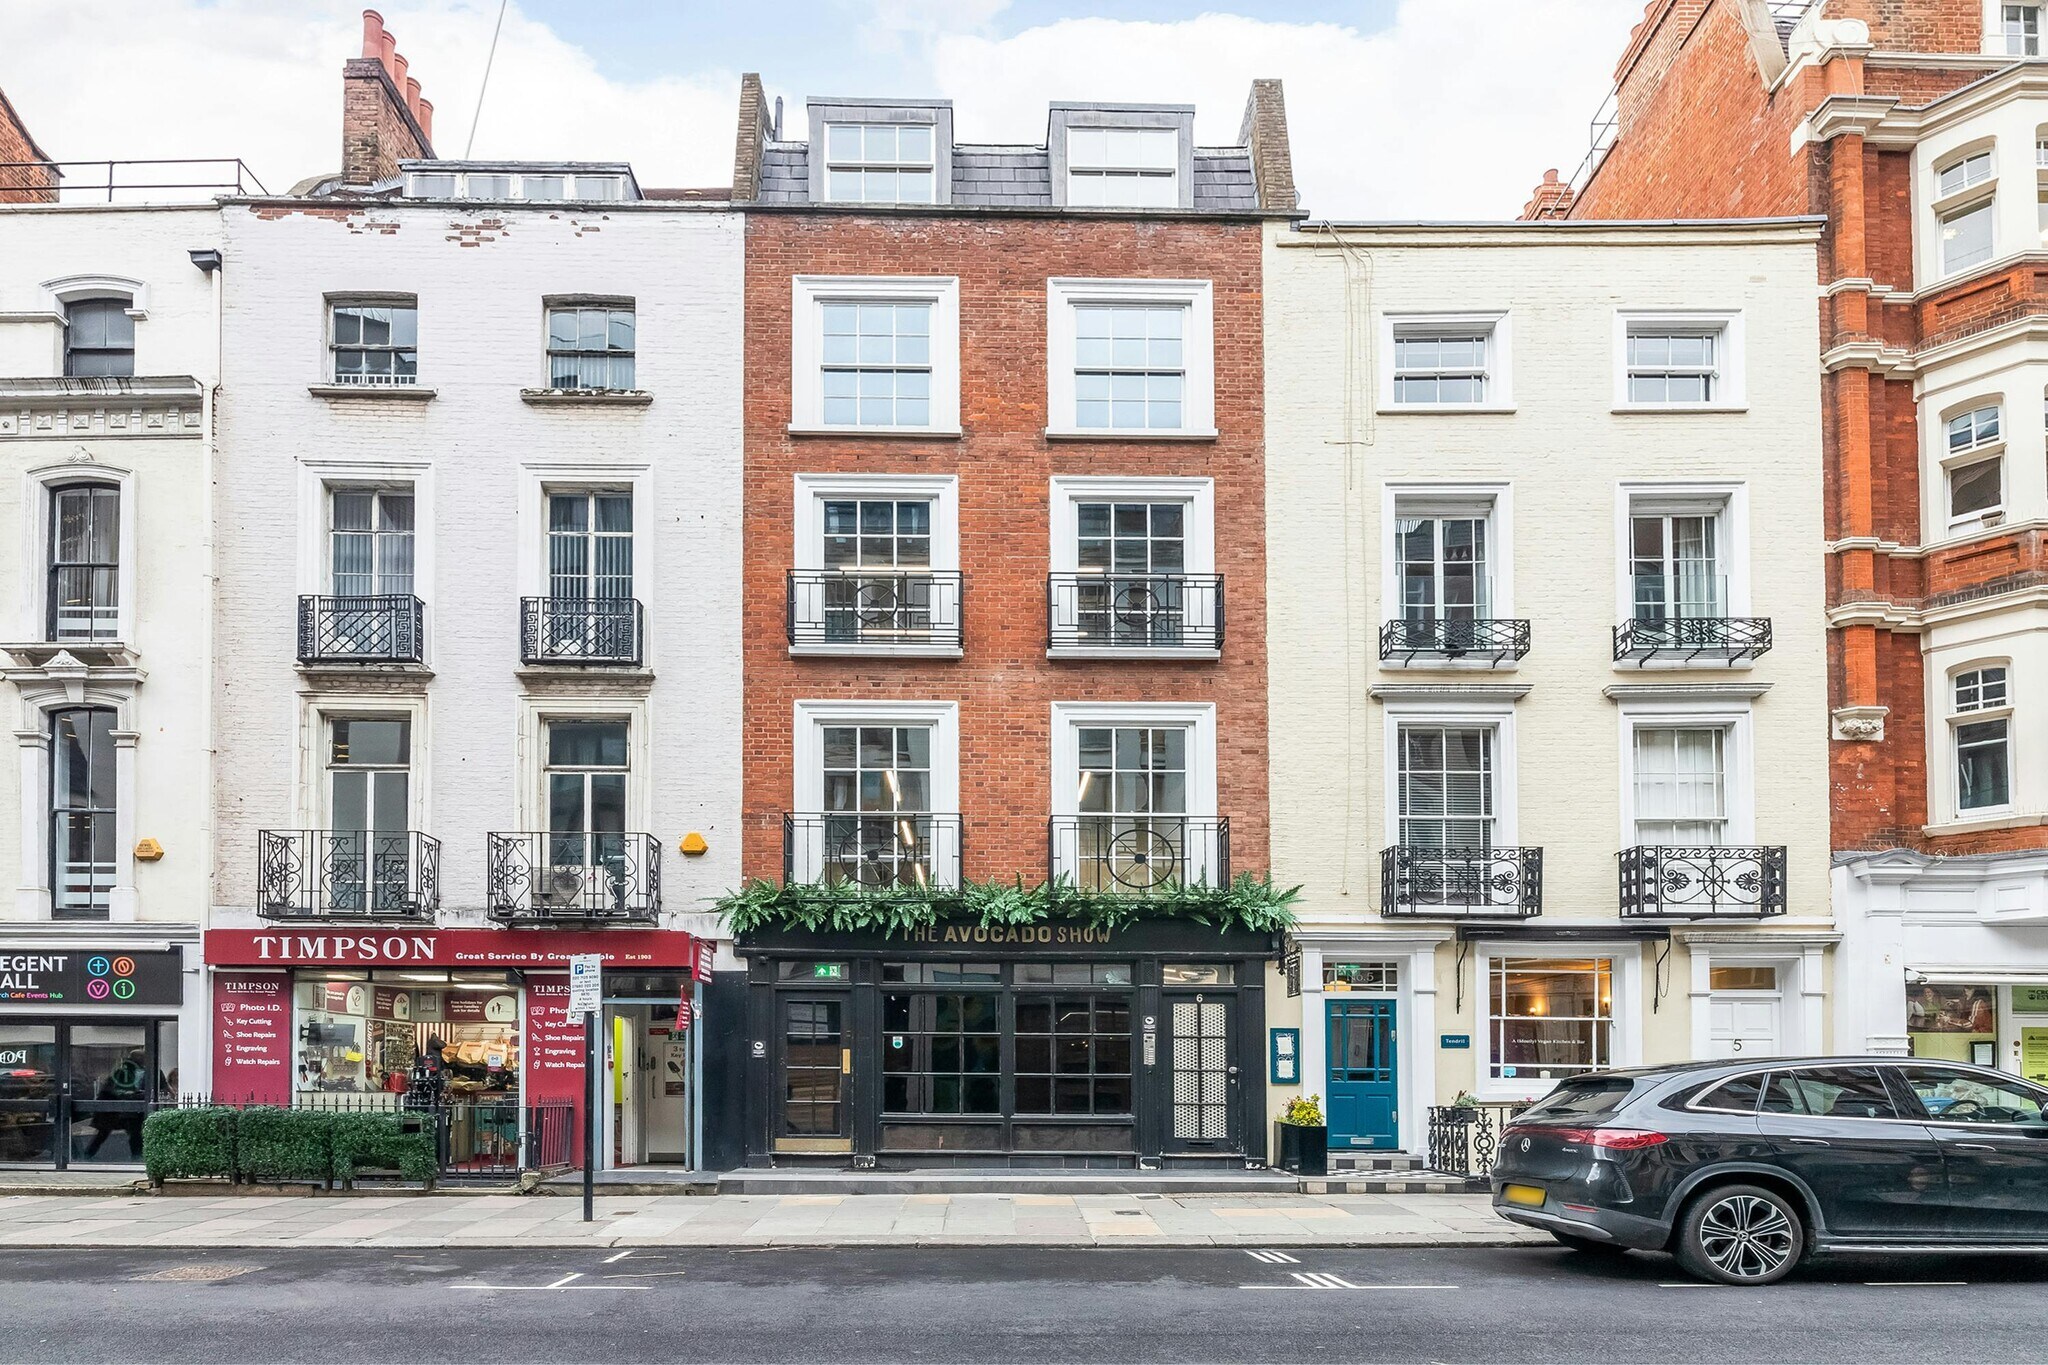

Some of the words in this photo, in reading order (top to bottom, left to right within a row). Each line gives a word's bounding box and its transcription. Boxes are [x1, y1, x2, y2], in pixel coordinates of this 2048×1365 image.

[944, 926, 1051, 943] AVOCADO
[1057, 927, 1111, 943] SHOW
[253, 936, 437, 960] TIMPSON
[531, 953, 544, 961] By
[0, 956, 68, 972] EGENT
[576, 965, 583, 973] P
[0, 973, 39, 989] ALL
[225, 982, 279, 990] TIMPSON
[533, 985, 570, 993] TIMPS
[1196, 993, 1203, 1002] 6
[248, 1018, 272, 1026] Cutting
[236, 1045, 268, 1053] Engraving
[1733, 1039, 1742, 1051] 5
[545, 1048, 576, 1056] Engraving
